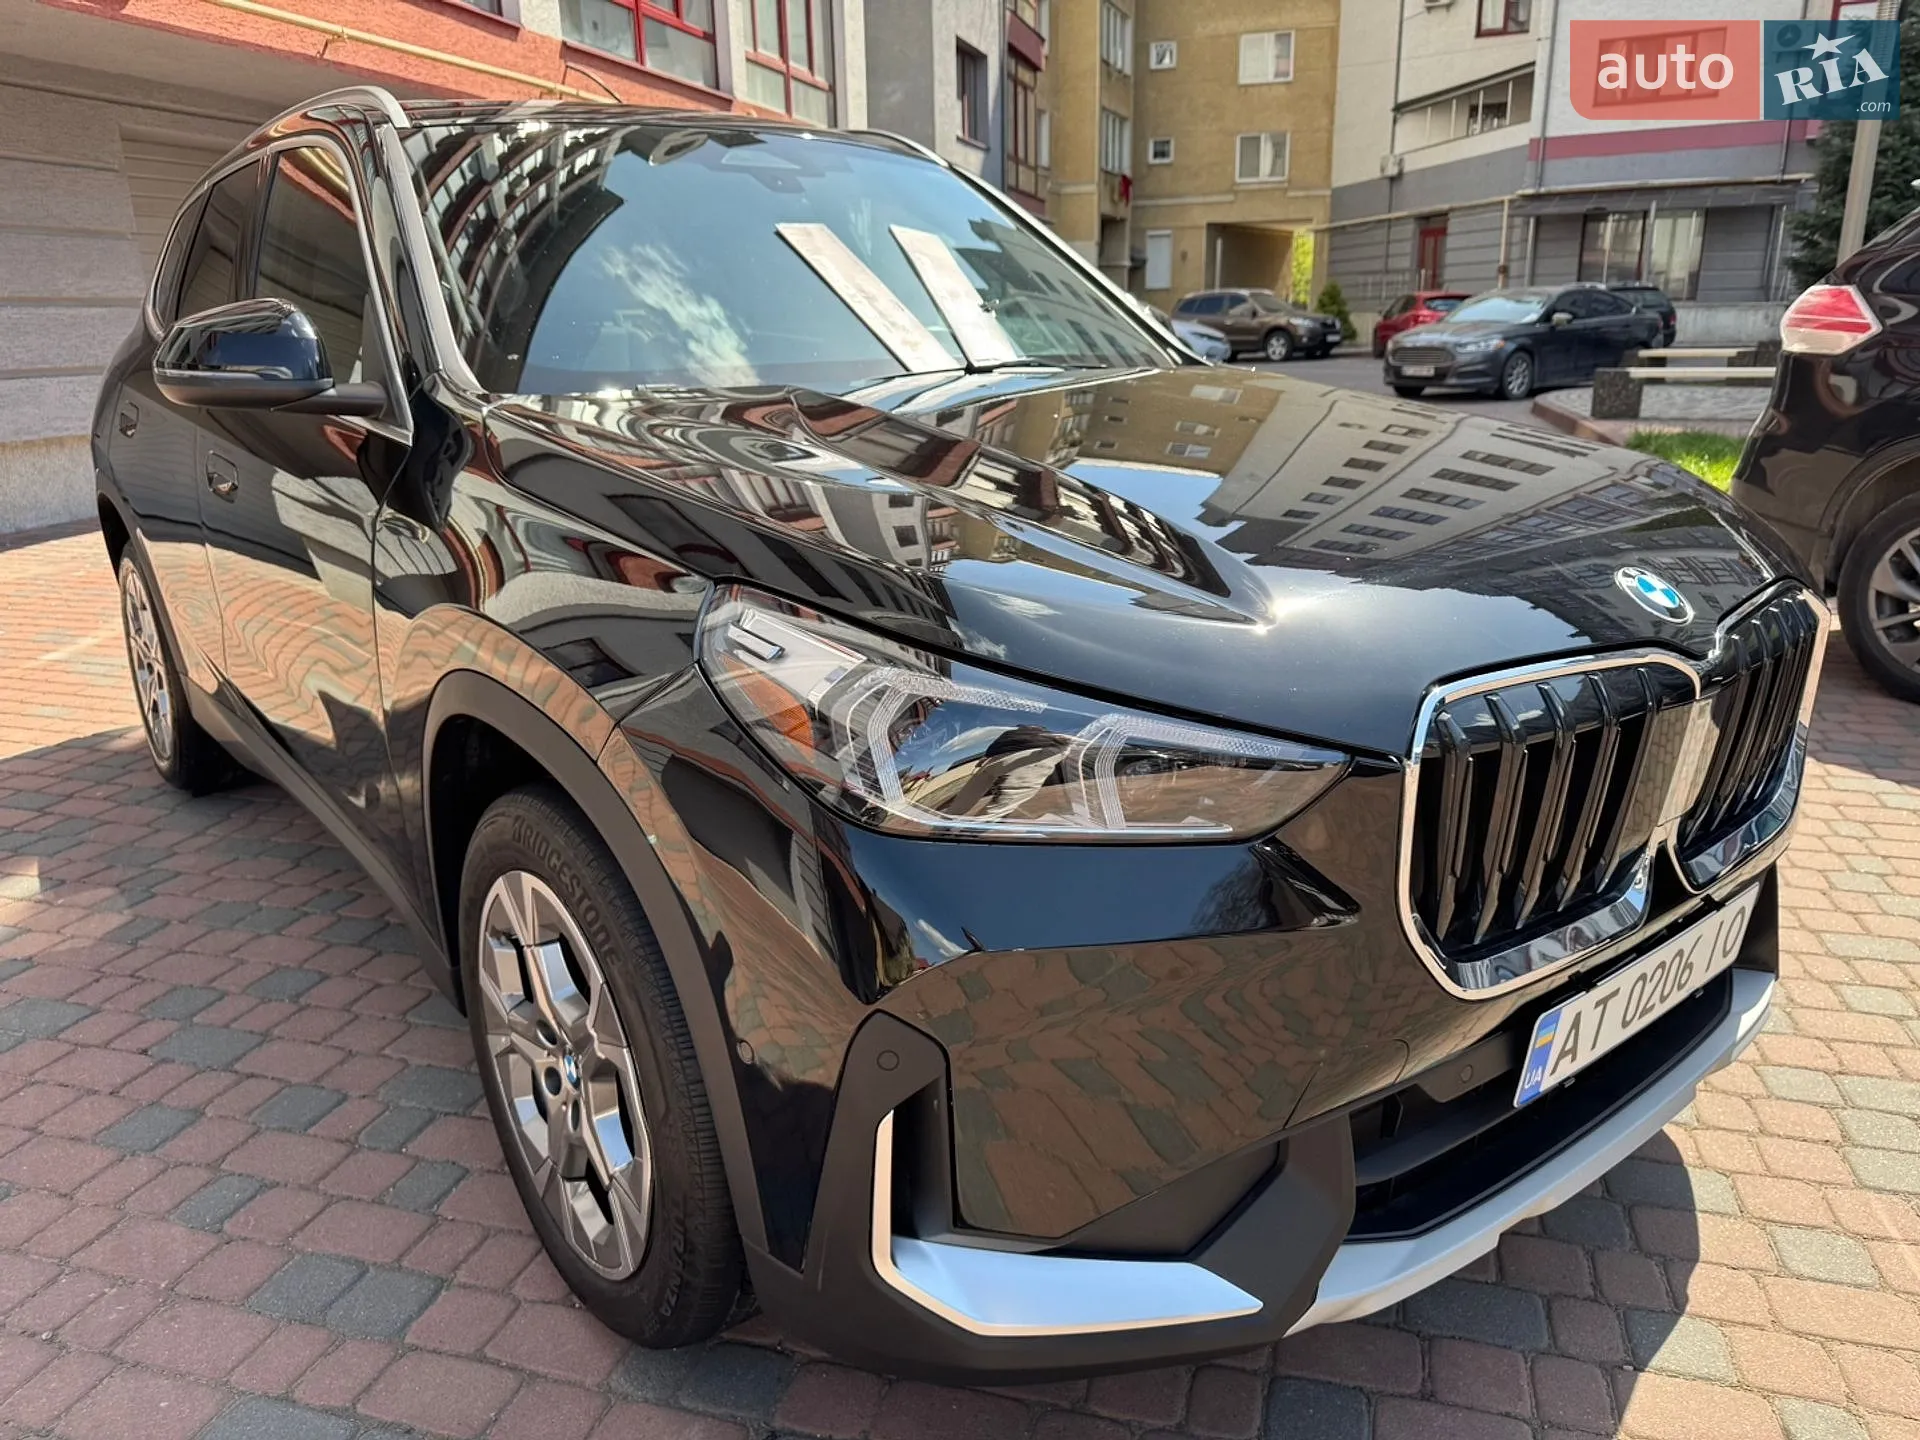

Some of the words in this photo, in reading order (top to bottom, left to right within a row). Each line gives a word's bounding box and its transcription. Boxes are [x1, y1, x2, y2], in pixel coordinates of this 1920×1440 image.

[511, 814, 622, 966] BRIDGESTONE
[1550, 987, 1621, 1077] AT
[1621, 934, 1702, 1029] 0206
[1705, 905, 1746, 973] IO
[1525, 1065, 1542, 1089] UA
